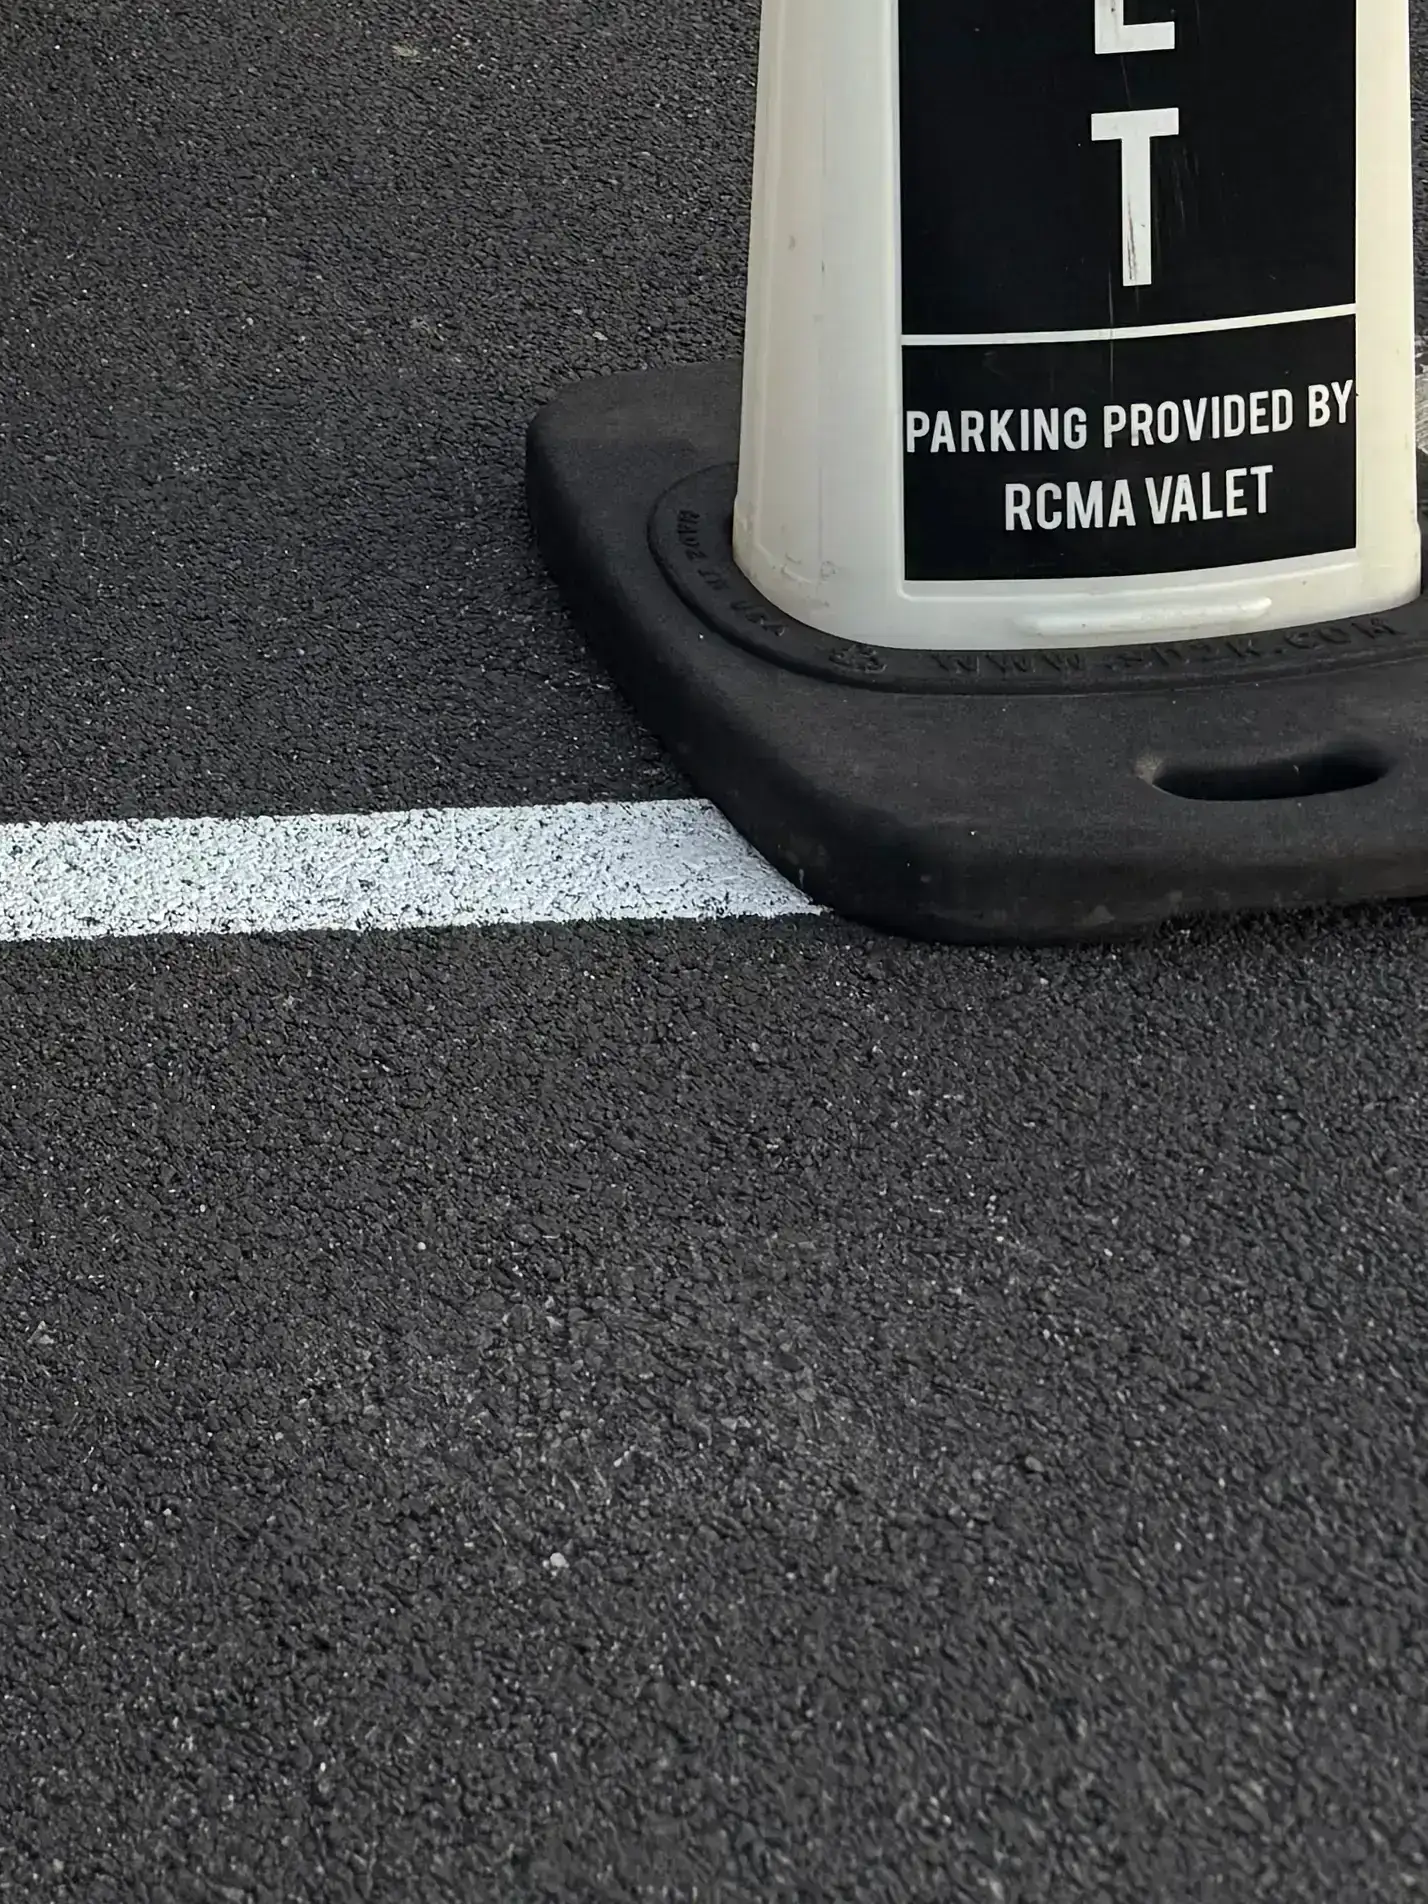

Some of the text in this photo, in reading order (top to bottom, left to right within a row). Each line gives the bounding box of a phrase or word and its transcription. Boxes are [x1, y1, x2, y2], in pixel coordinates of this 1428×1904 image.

[906, 379, 1354, 453] PARKING PROVIDED BY
[1005, 464, 1274, 531] RCMA VALET
